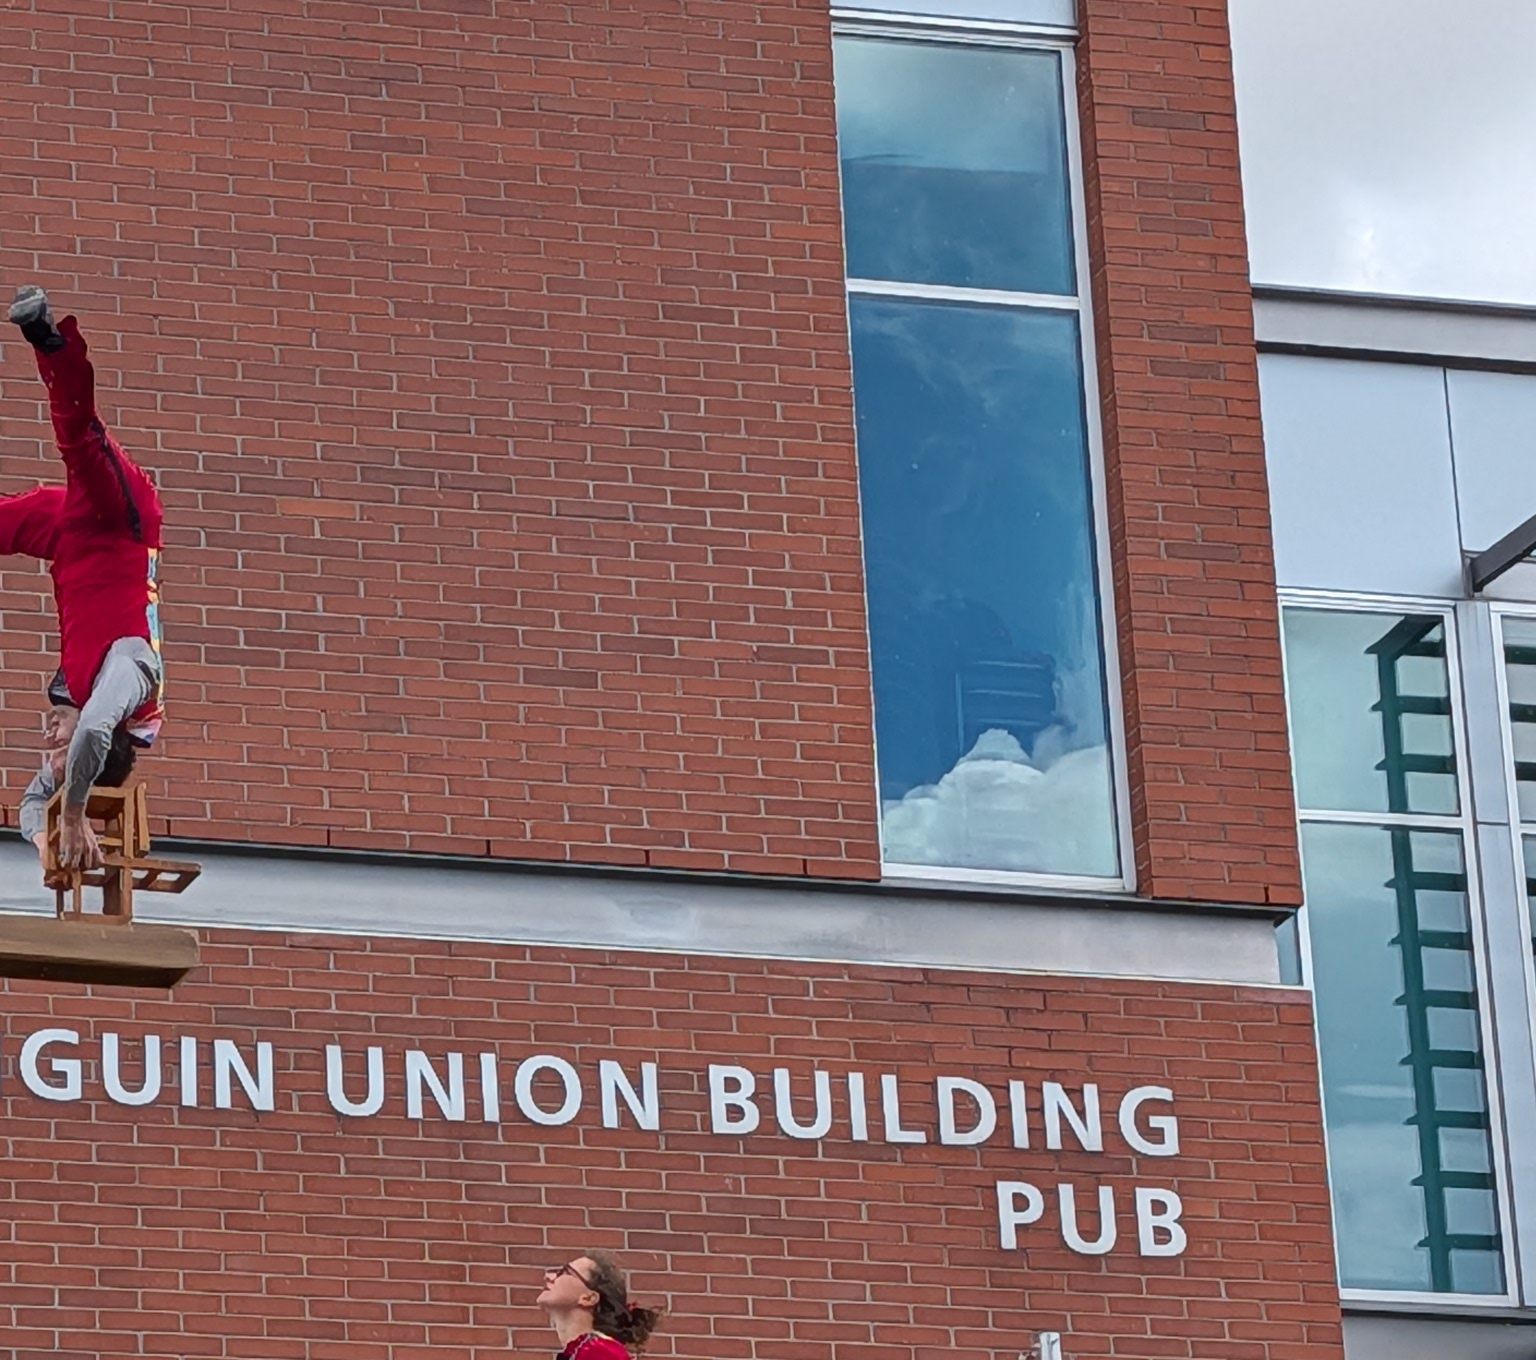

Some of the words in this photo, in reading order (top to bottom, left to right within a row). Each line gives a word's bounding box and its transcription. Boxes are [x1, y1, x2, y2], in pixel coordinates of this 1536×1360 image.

[326, 1043, 660, 1131] UNION
[708, 1064, 1181, 1157] BUILDING
[996, 1180, 1188, 1258] PUB
